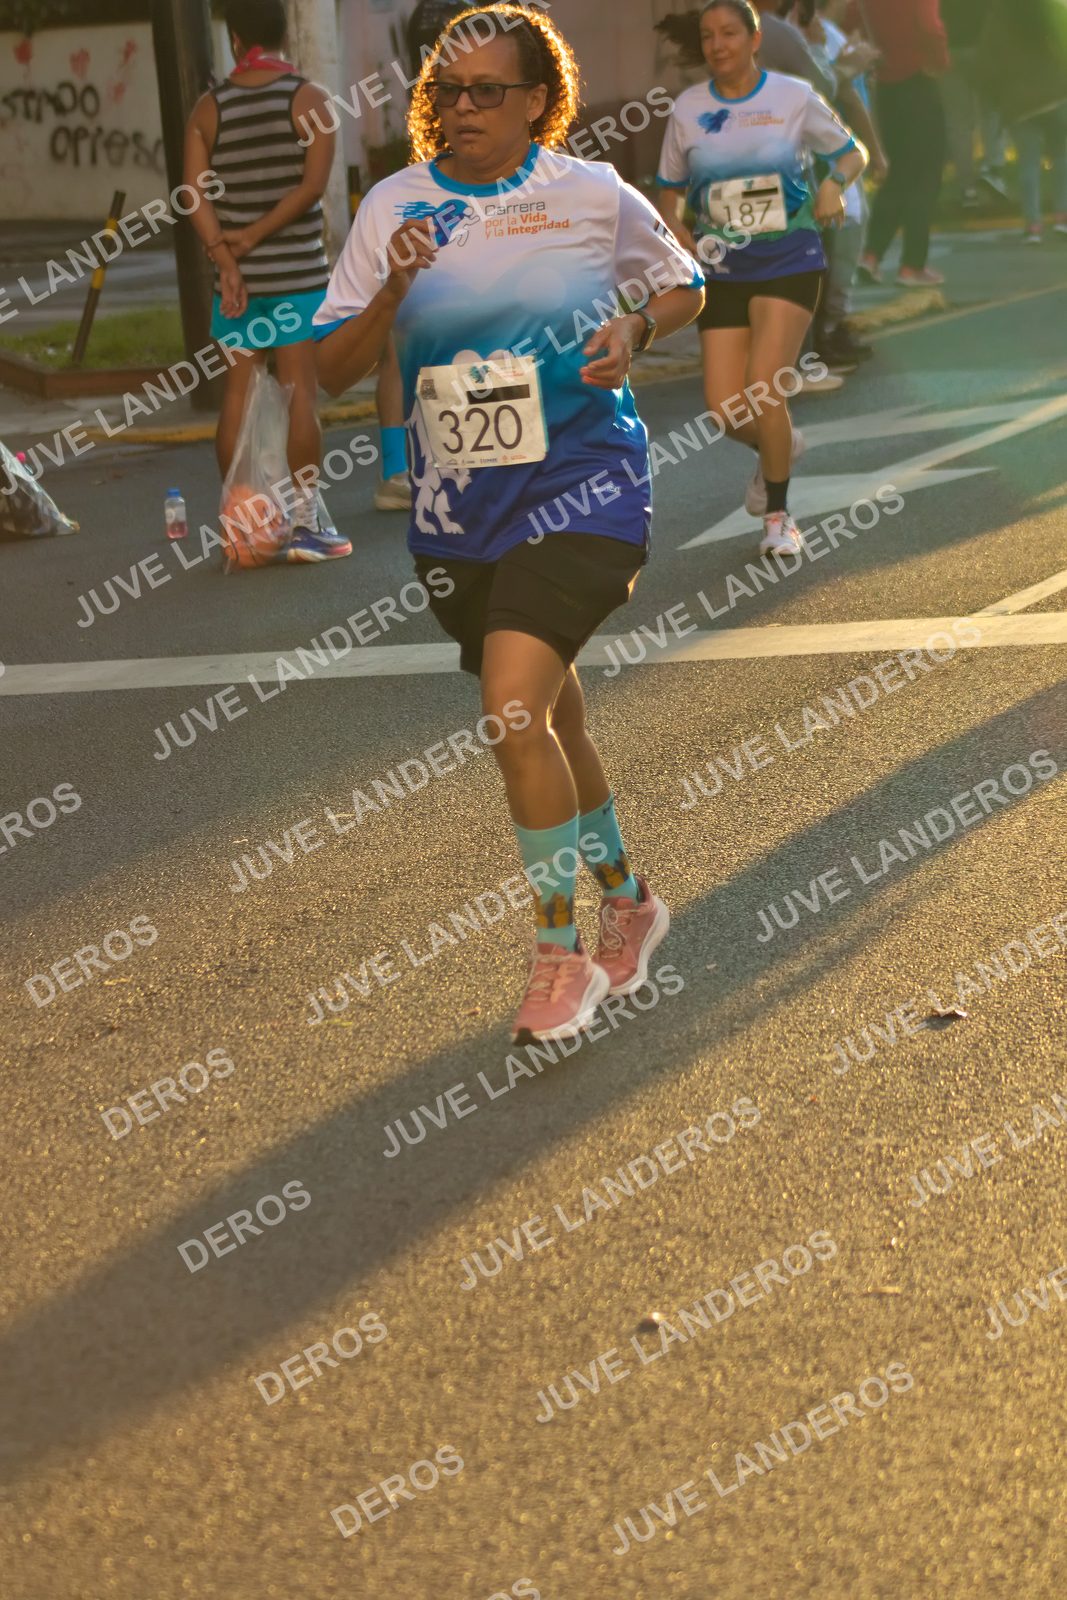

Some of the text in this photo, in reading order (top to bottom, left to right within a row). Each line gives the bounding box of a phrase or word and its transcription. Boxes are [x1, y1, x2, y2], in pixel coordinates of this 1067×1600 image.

[485, 201, 546, 217] Carrera
[723, 200, 772, 227] 187
[485, 212, 547, 229] por la Vida
[485, 219, 570, 240] y la Integridad
[438, 404, 523, 454] 320
